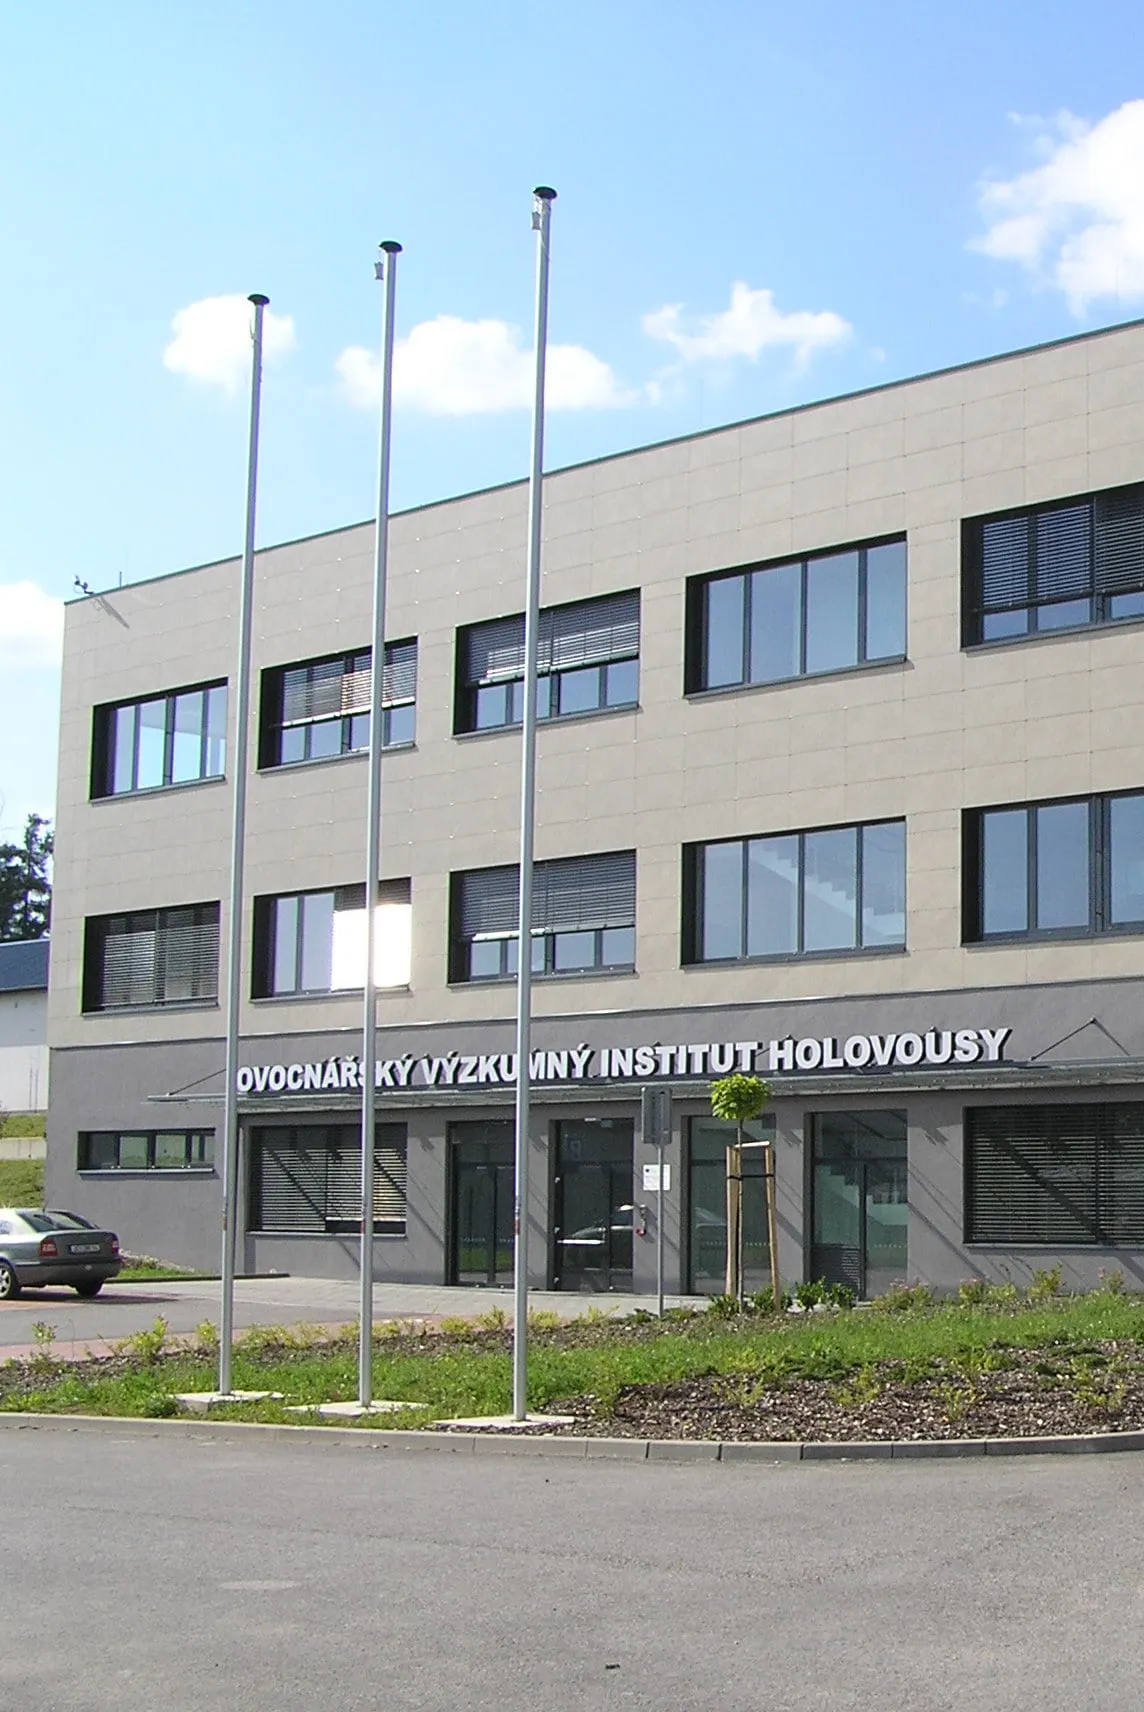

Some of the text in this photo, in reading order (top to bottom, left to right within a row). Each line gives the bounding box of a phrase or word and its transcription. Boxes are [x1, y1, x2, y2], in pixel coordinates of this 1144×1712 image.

[421, 1044, 592, 1084] VÝZKUMNÝ
[600, 1041, 758, 1077] INSTITUT
[768, 1028, 1011, 1070] HOLOVOUSY
